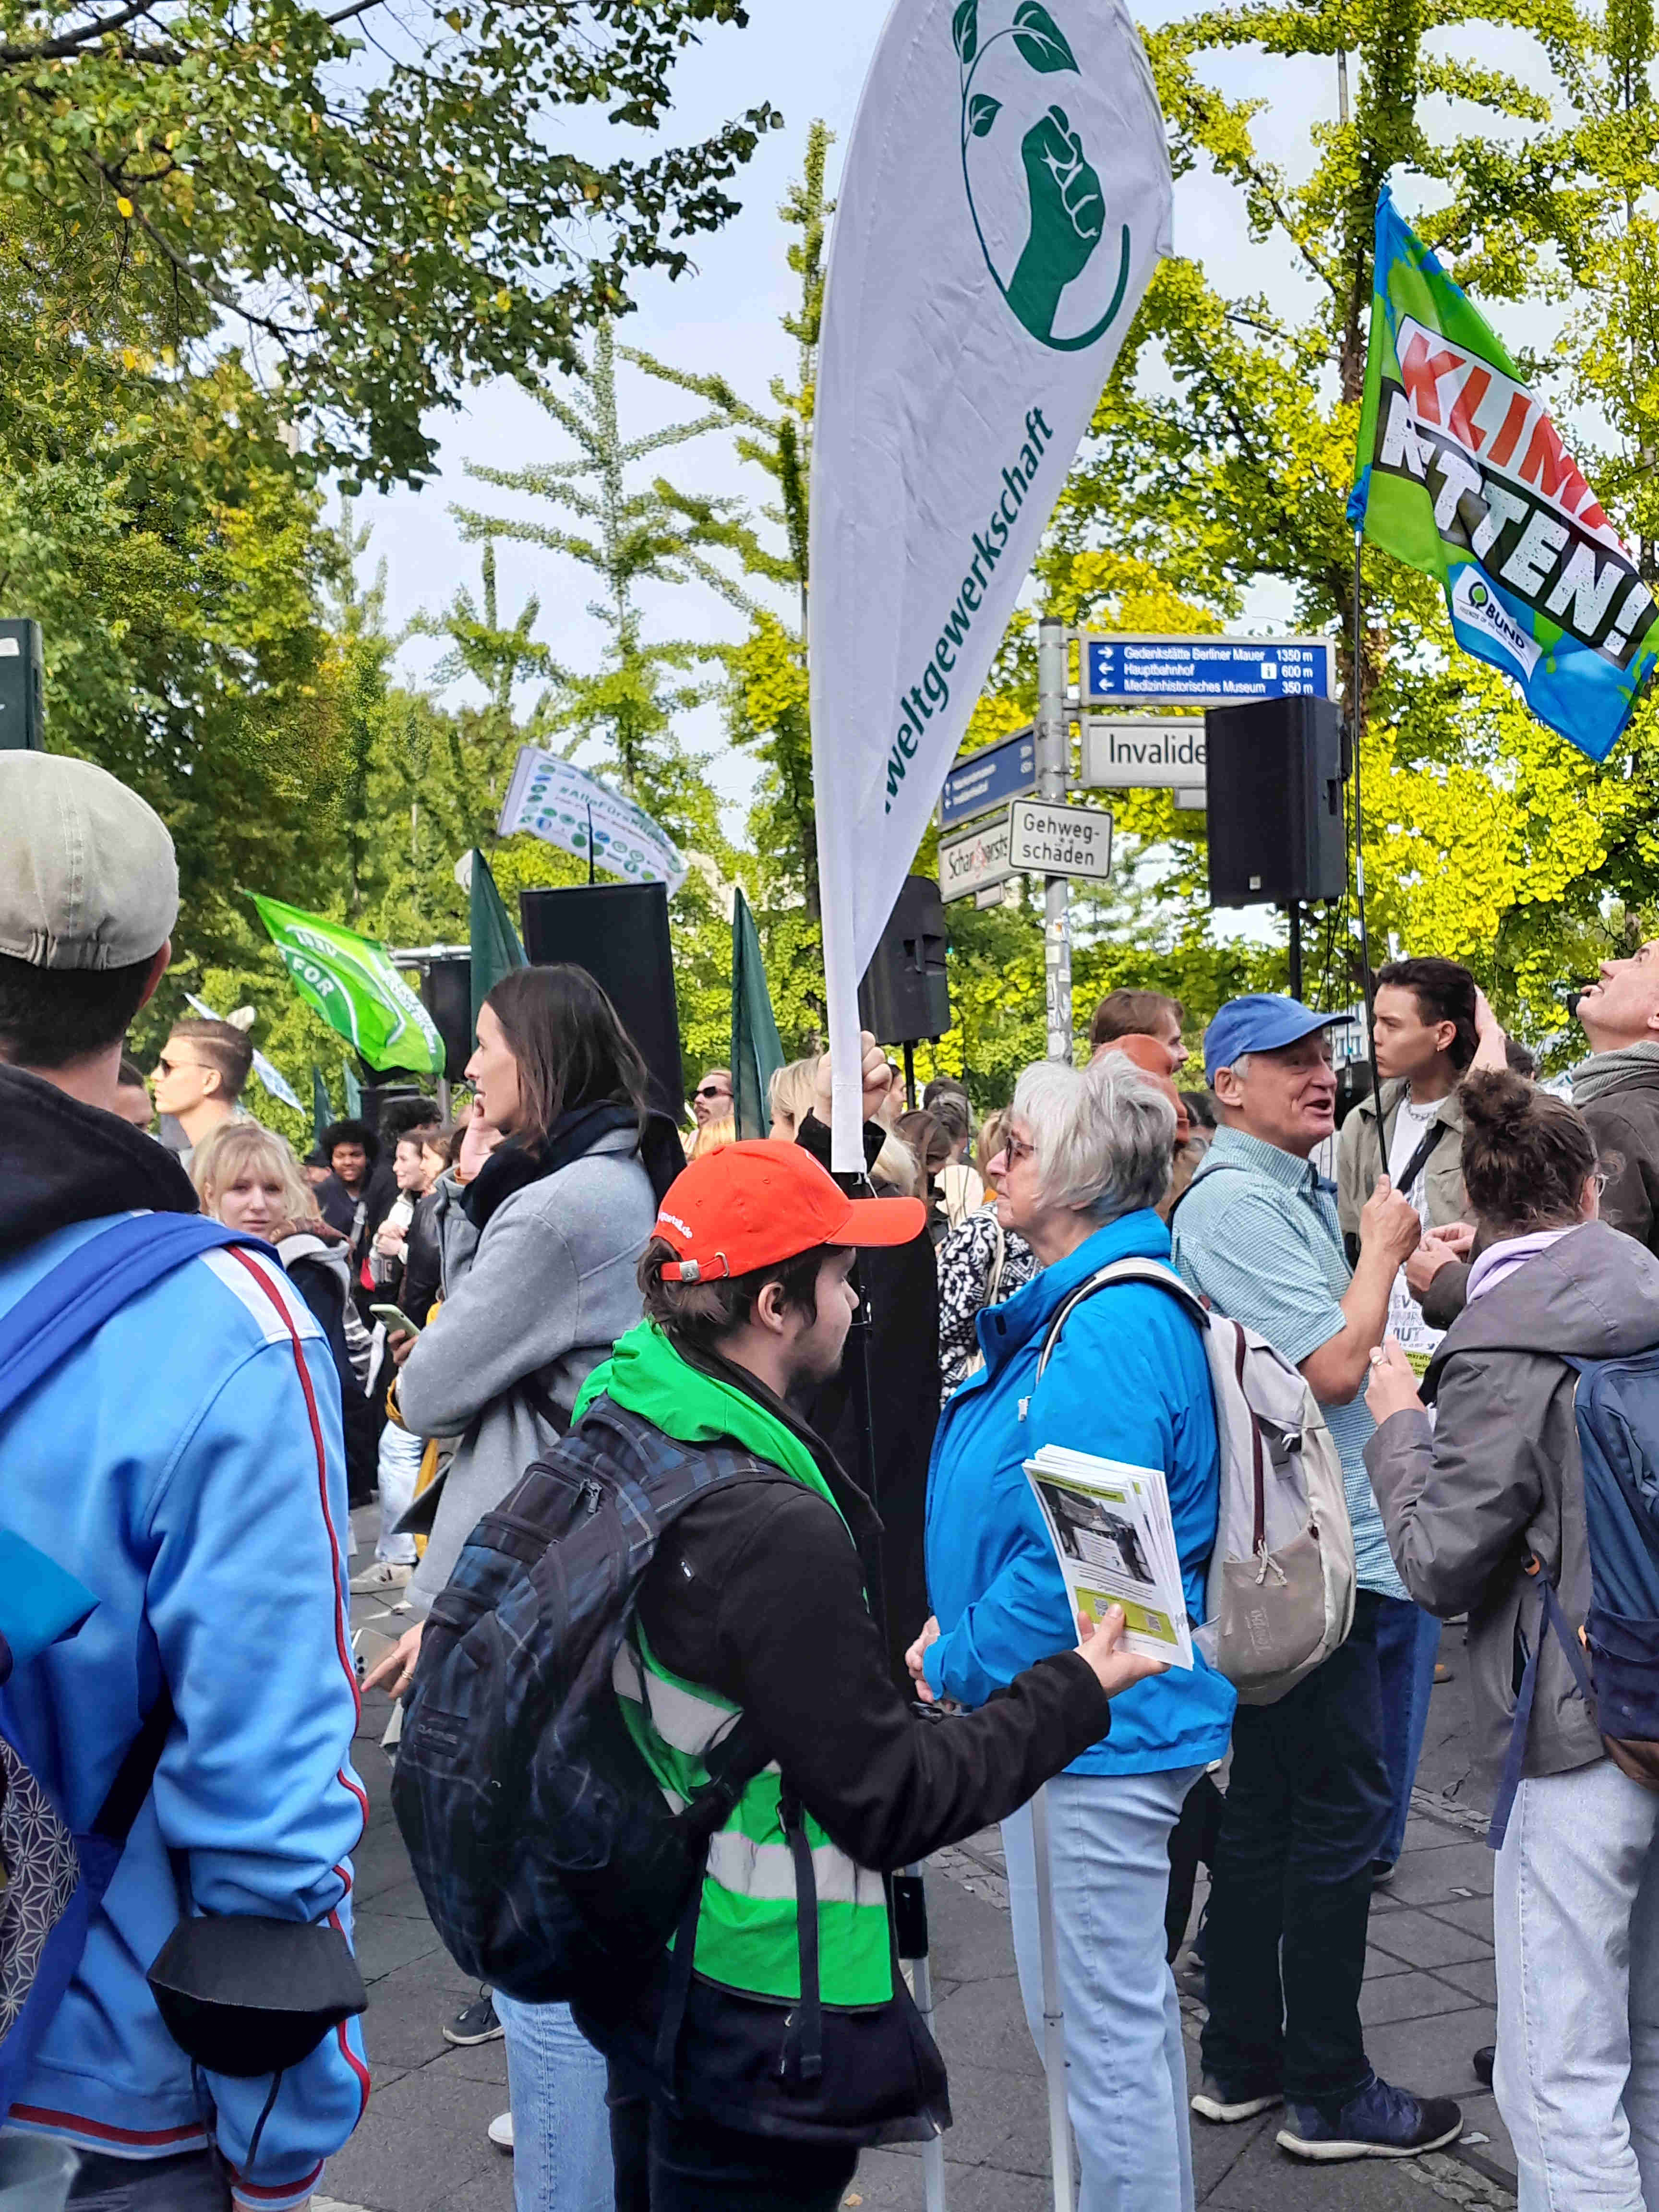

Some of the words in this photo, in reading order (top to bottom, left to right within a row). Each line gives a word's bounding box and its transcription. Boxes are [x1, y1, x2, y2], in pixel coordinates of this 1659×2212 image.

[885, 406, 1054, 815] weltgewerkschaft
[1485, 603, 1525, 649] BUND
[1124, 647, 1190, 660] Gedenkstätte
[1192, 648, 1232, 661] Berliner
[1233, 648, 1265, 661] Mauer
[1276, 649, 1301, 662] 1350
[1302, 652, 1313, 662] m
[1124, 663, 1195, 677] Hauptbahnhof
[1281, 665, 1301, 678] 600
[1303, 668, 1313, 678] m
[1124, 679, 1221, 692] Medizinhistorisches
[1223, 680, 1266, 693] Museum
[1282, 681, 1301, 694] 350
[1303, 684, 1313, 694] m
[1110, 734, 1208, 764] Invalide
[1023, 812, 1100, 843] Gehweg-
[1022, 838, 1094, 866] schäden
[292, 956, 335, 997] FOR
